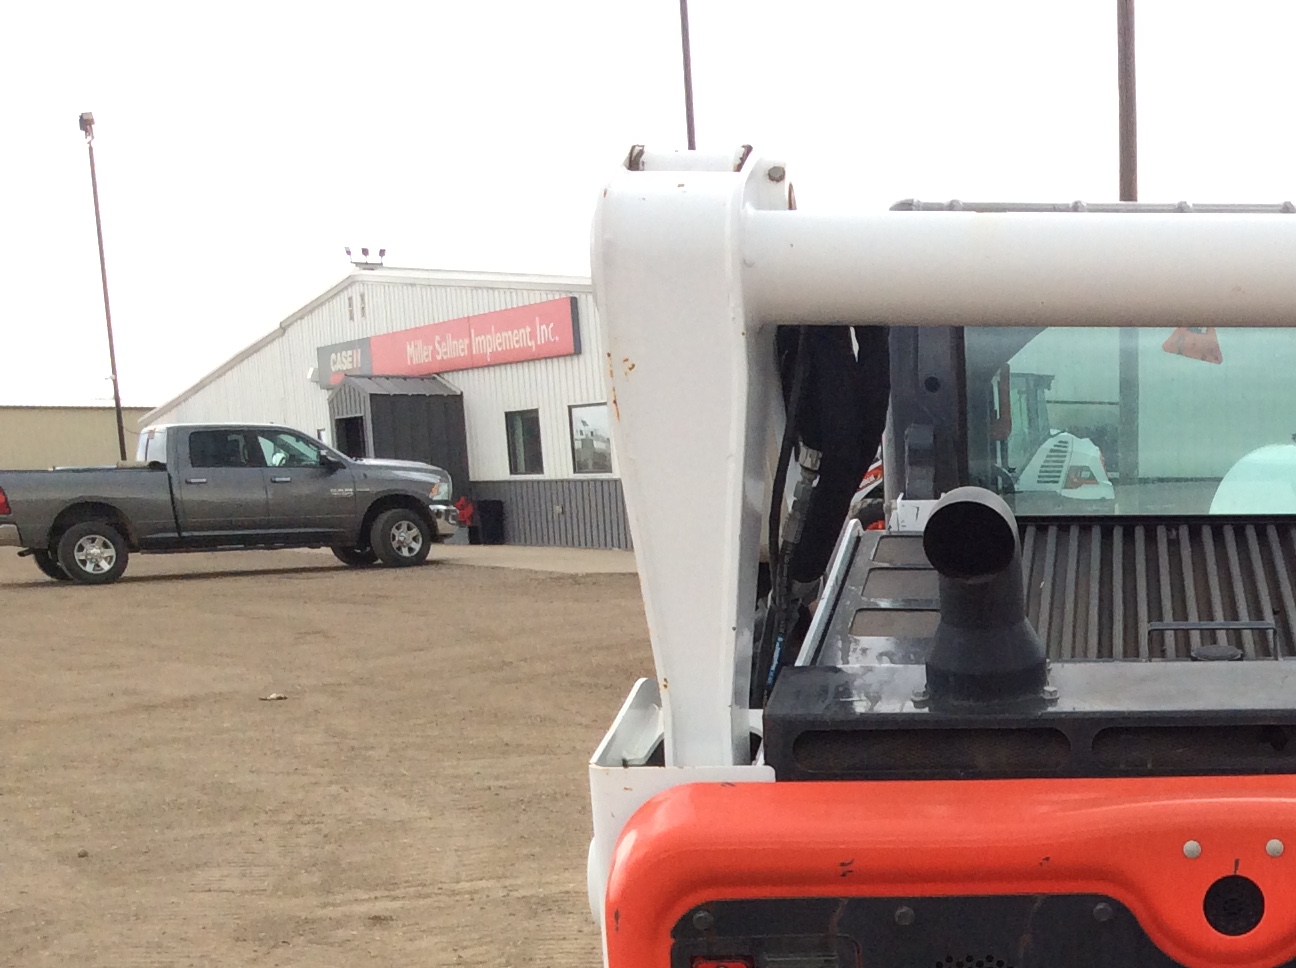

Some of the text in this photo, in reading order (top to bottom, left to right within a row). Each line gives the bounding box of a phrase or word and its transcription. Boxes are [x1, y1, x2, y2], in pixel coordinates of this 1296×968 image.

[406, 317, 559, 365] Miller Sellner Implement, Inc.
